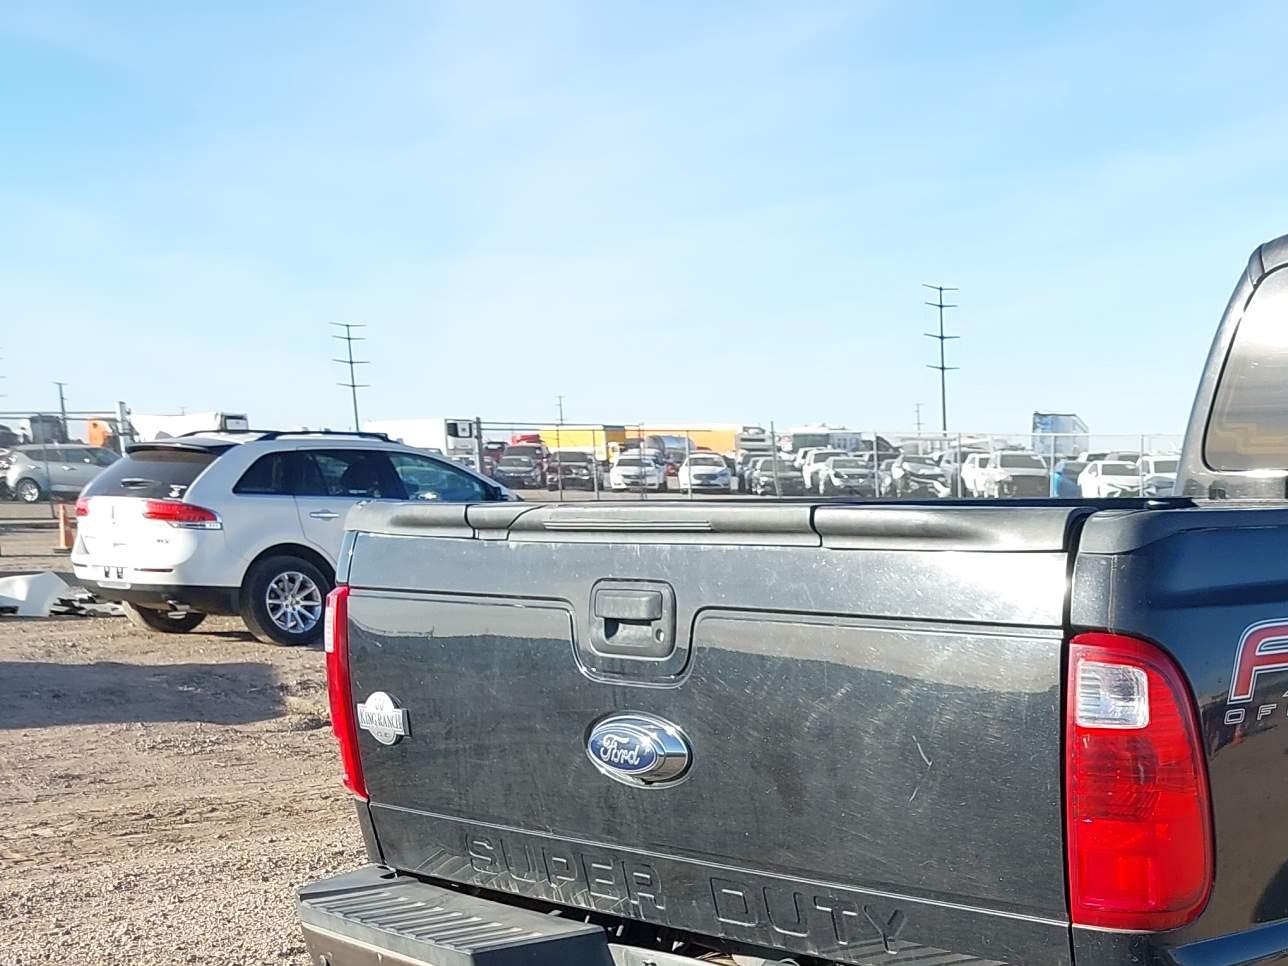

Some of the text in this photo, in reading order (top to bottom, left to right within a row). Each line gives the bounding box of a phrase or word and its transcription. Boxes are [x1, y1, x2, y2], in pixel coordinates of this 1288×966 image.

[600, 734, 640, 766] Ford
[463, 832, 908, 956] SUPER DUTY
